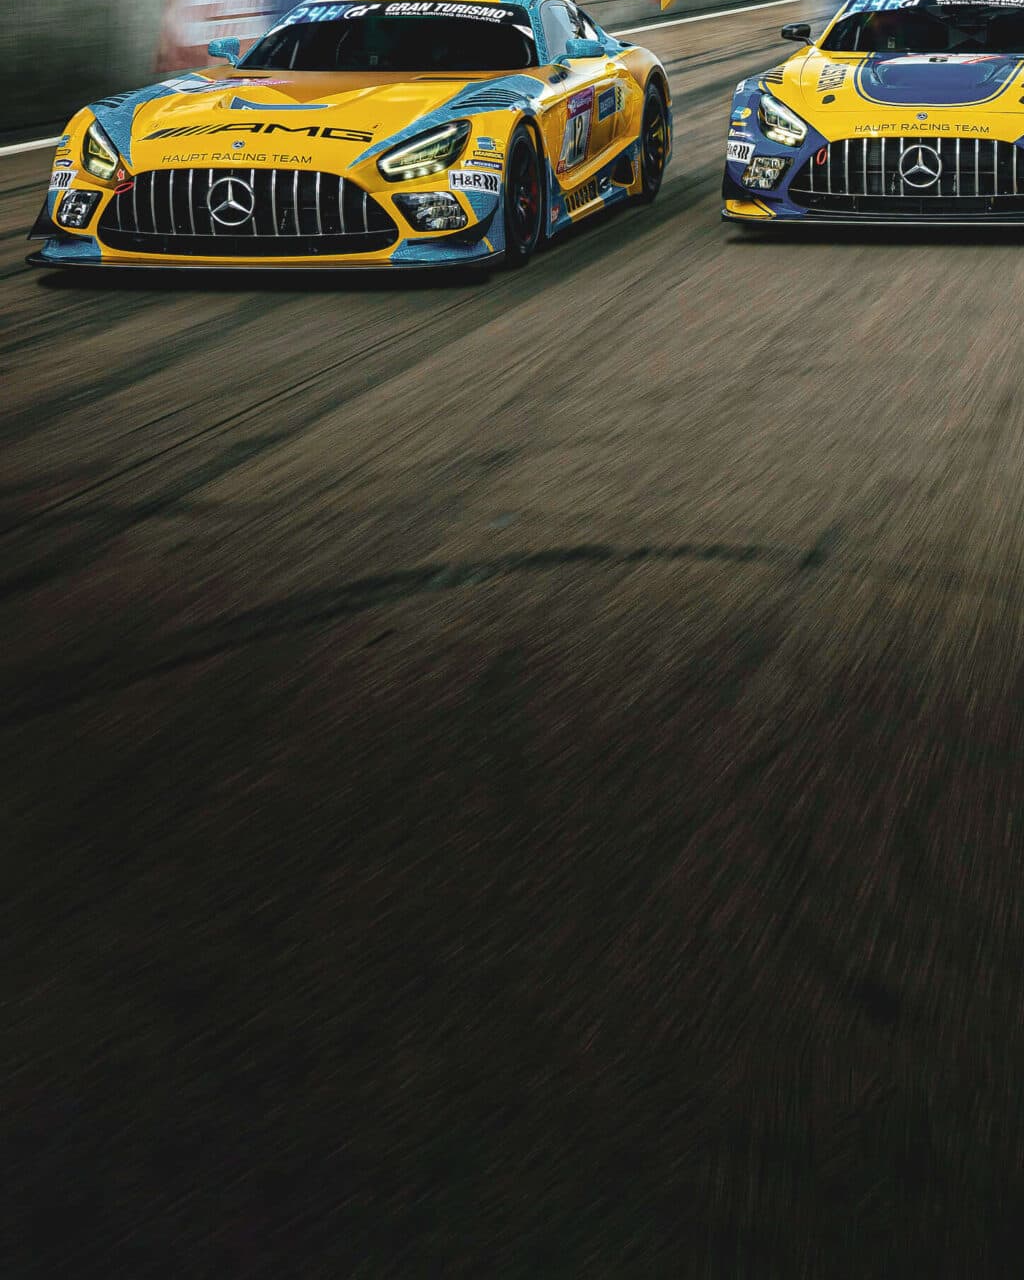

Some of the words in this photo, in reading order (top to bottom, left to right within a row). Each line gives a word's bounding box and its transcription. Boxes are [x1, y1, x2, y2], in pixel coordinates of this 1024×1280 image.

[385, 2, 434, 12] GRAN
[455, 13, 501, 23] SIMULATOR
[208, 122, 374, 143] AMG
[854, 124, 896, 133] HAUPT
[900, 124, 950, 132] RACING
[955, 124, 990, 133] TEAM
[161, 153, 208, 163] HAUPT
[211, 152, 267, 163] RACING
[272, 154, 312, 164] TEAM
[452, 173, 482, 187] H&R
